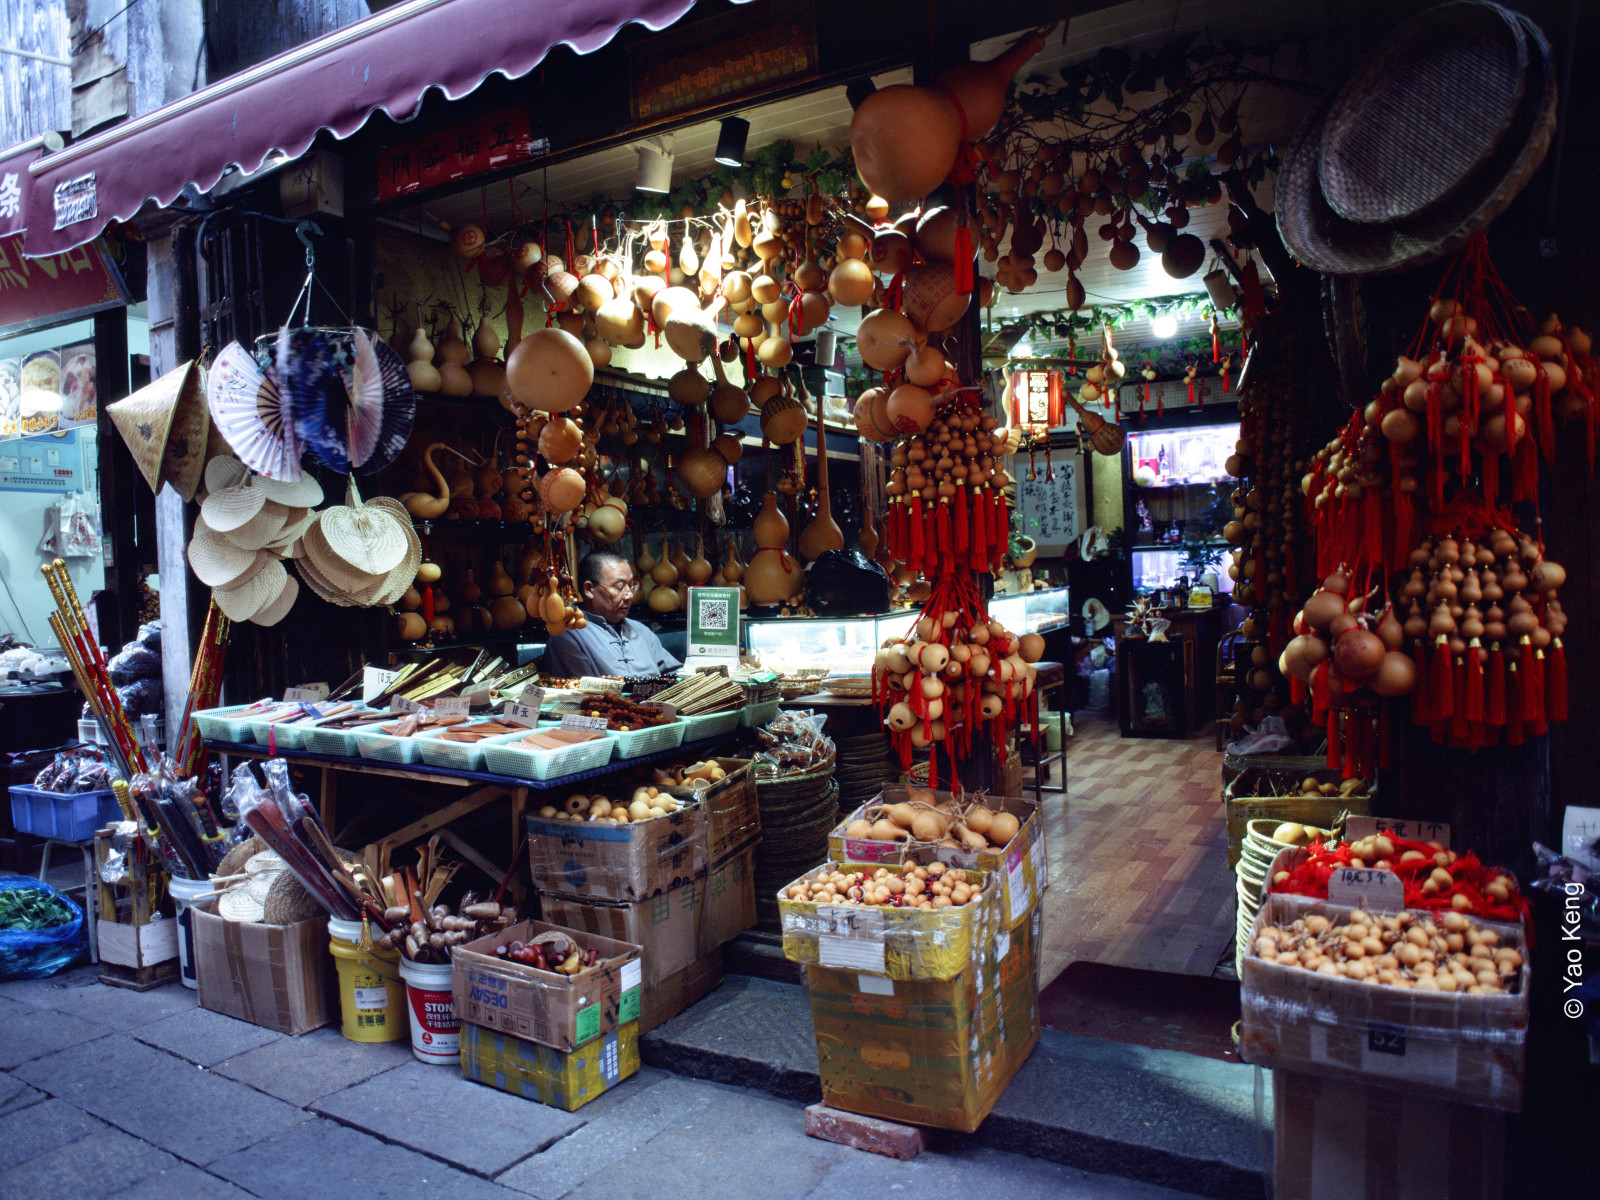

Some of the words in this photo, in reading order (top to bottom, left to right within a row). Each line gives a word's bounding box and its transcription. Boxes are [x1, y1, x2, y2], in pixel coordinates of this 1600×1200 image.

[524, 684, 541, 698] 25元
[511, 704, 529, 718] 10元
[1341, 871, 1387, 886] 10元3个
[468, 985, 508, 1009] DESAY
